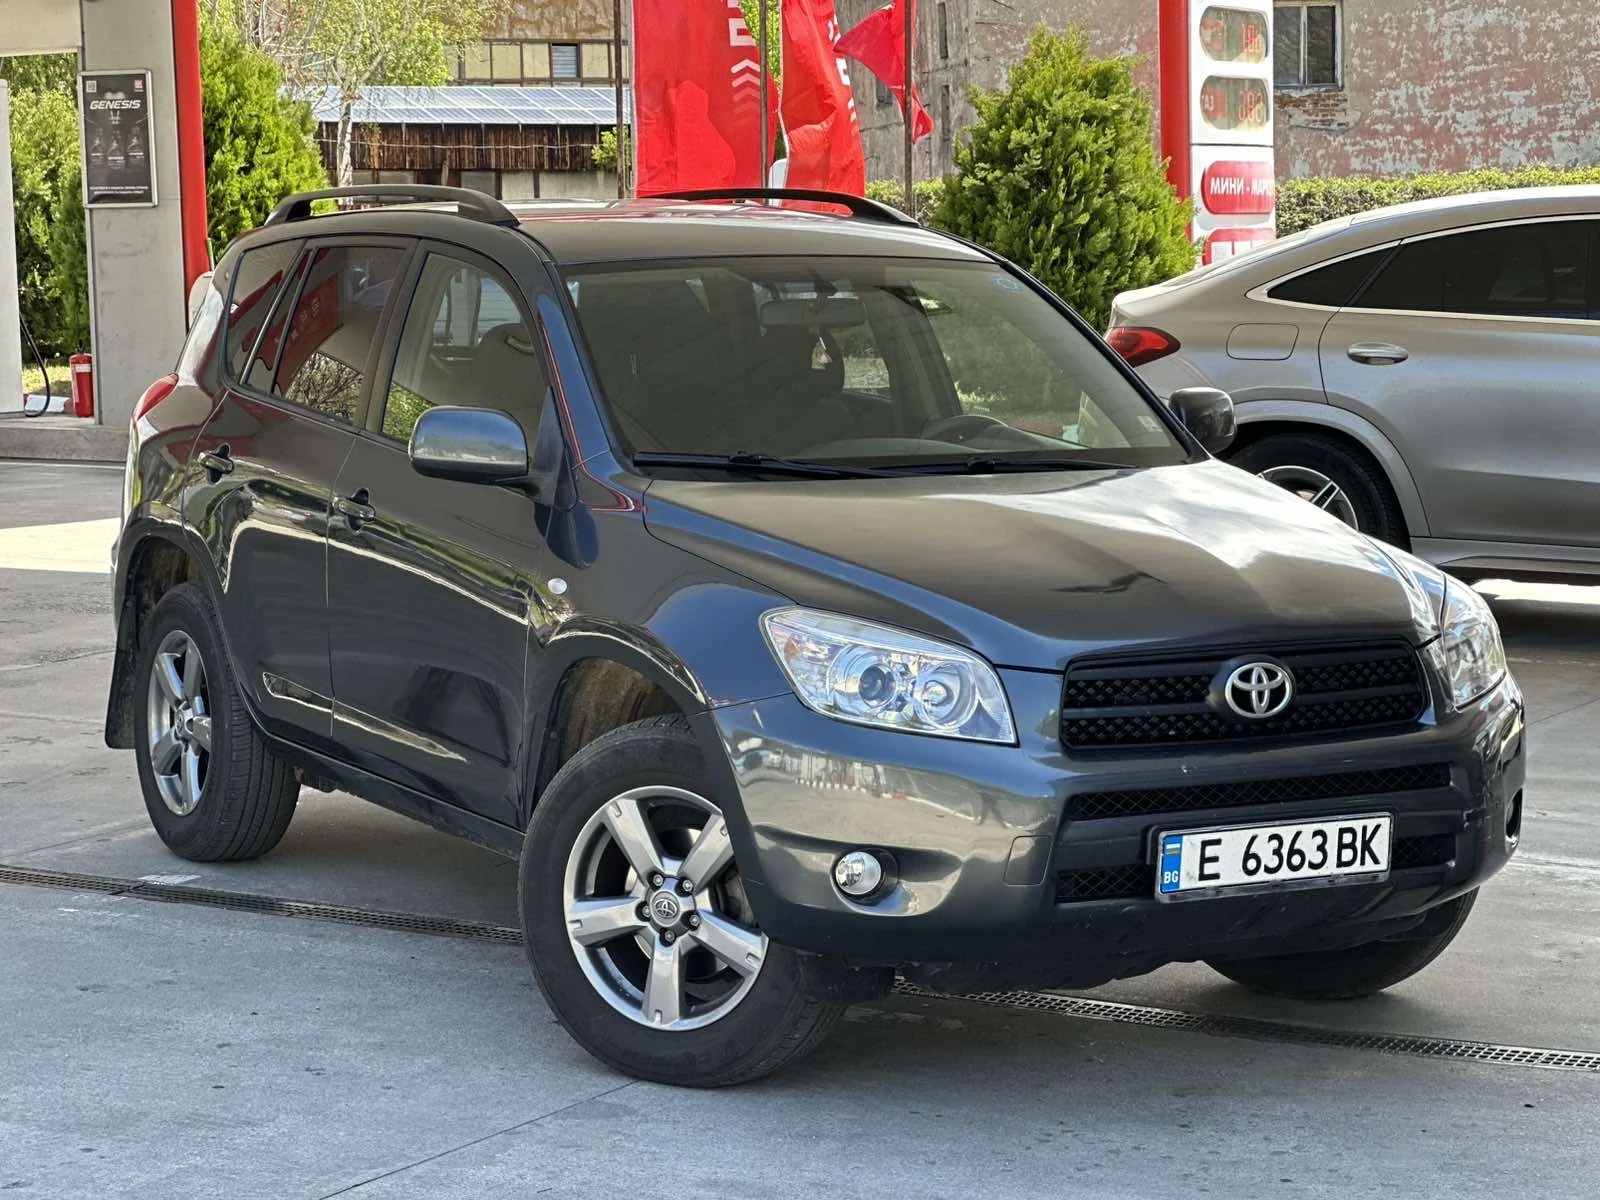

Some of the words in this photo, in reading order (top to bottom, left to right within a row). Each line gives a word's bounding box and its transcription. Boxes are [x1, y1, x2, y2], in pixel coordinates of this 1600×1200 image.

[89, 99, 141, 110] GENESIS
[1198, 838, 1222, 882] E
[1241, 829, 1328, 877] 6363
[1336, 823, 1382, 869] BK
[1163, 870, 1179, 884] BG
